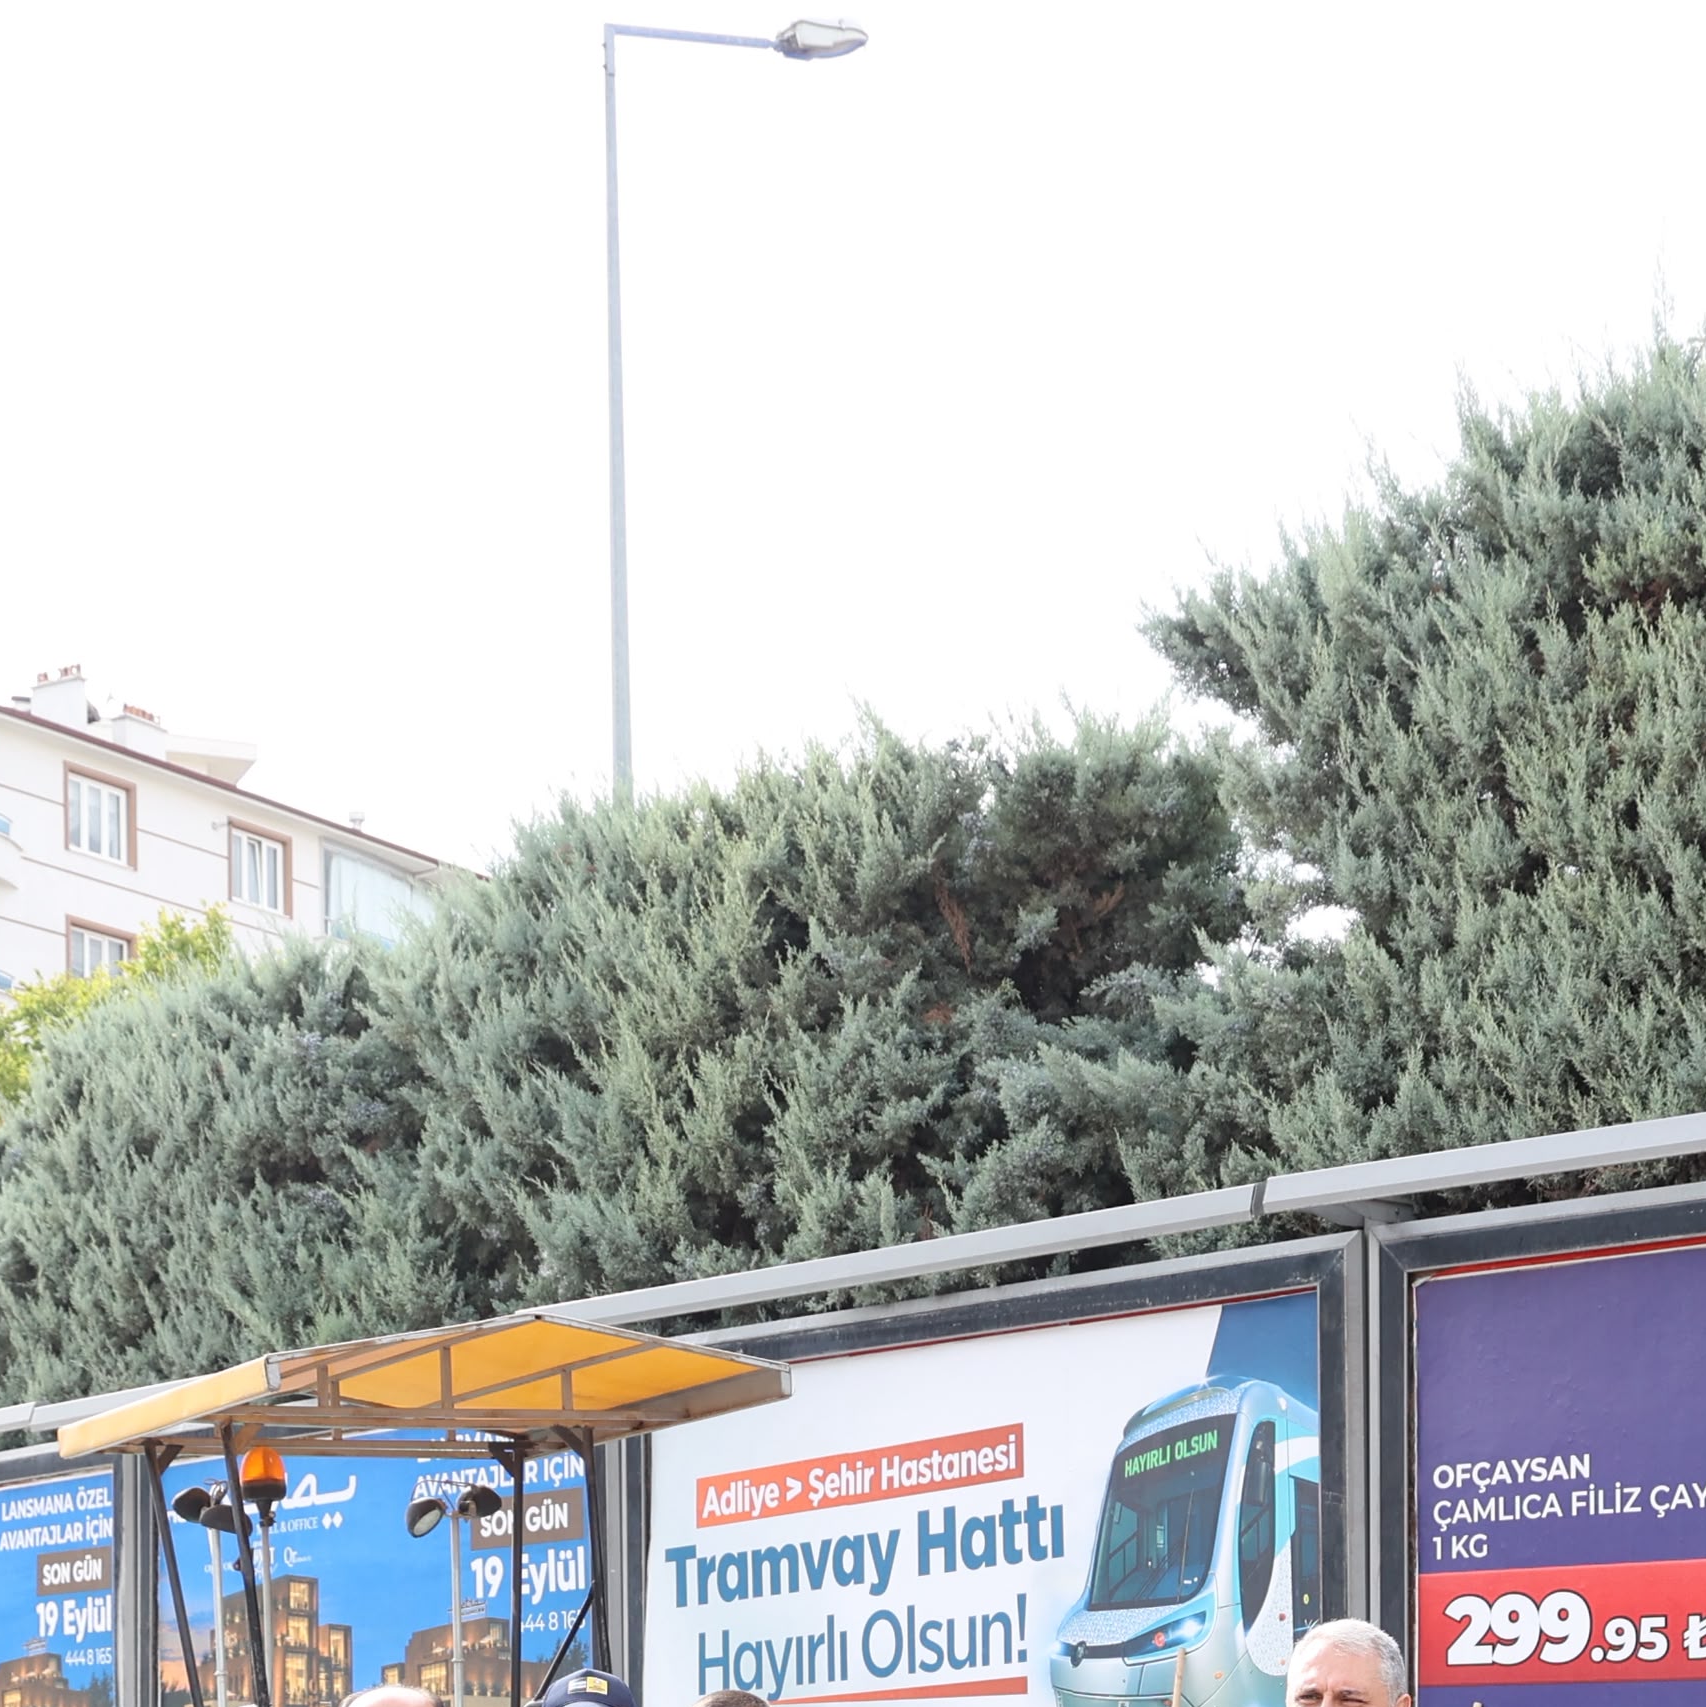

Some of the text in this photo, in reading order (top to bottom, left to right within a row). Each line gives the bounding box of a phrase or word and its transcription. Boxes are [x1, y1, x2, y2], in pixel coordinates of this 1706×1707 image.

[1124, 1429, 1219, 1479] HAYIRLI OLSUN
[1432, 1453, 1592, 1494] OFÇAYSAN
[413, 1461, 539, 1499] AVANTAJLR
[702, 1436, 1018, 1519] Adliye Şehir Hastanesi
[1, 1486, 112, 1522] LANSMANA ÖZEL
[524, 1498, 569, 1532] GÜN
[1432, 1492, 1563, 1531] ÇAMLICA
[1570, 1481, 1643, 1517] FİLİZ
[0, 1516, 114, 1552] AVANTAJLAR İÇİN
[665, 1495, 1066, 1610] Tramvay Hattı
[1431, 1533, 1490, 1560] 1 KG
[42, 1555, 102, 1586] SON GÜN
[470, 1545, 586, 1605] 19 Eylül
[36, 1594, 113, 1643] 19 Eylül
[548, 1611, 558, 1631] 8
[1443, 1586, 1669, 1668] 299.95
[64, 1646, 112, 1666] 444 8 165
[696, 1592, 1029, 1700] Hayırlı Olsun!
